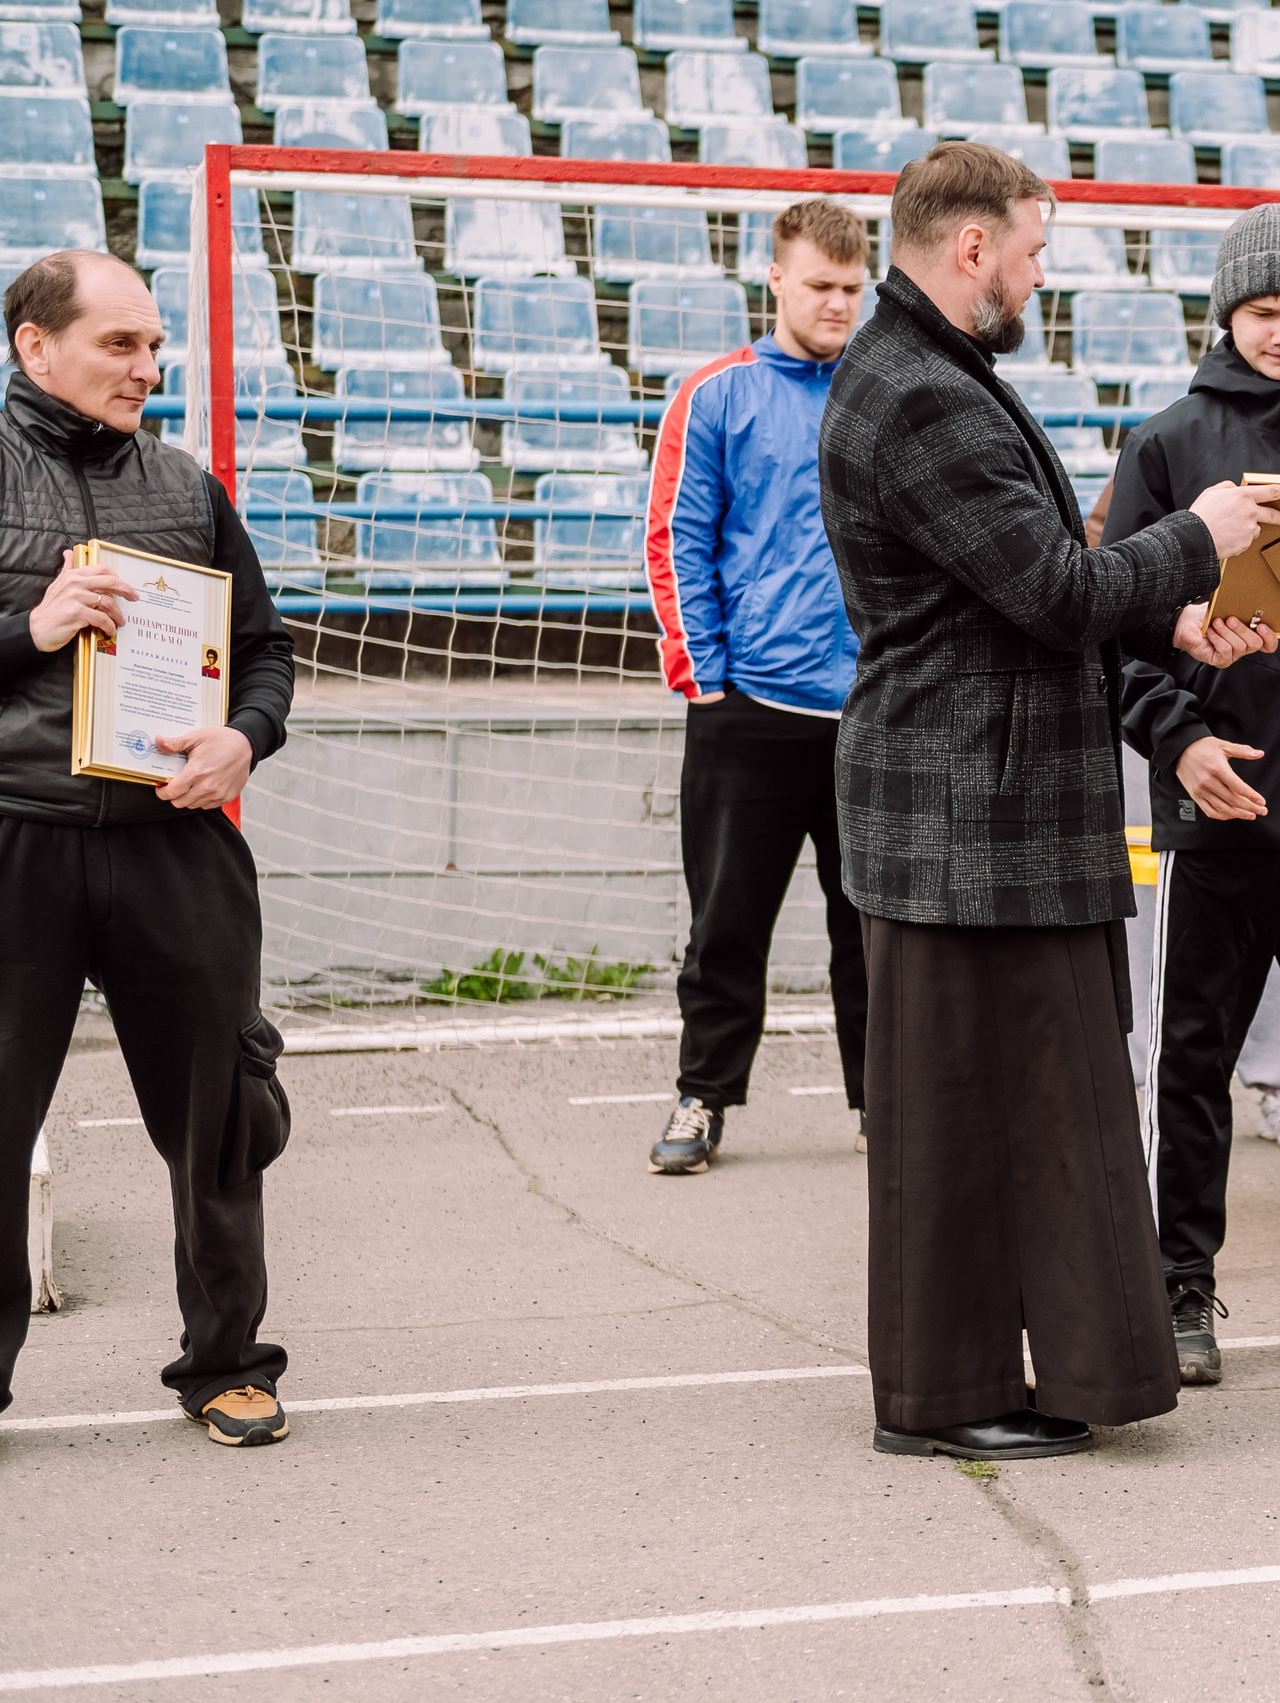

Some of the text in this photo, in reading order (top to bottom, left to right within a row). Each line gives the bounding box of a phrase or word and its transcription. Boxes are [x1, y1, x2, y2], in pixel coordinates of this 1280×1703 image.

[127, 615, 200, 639] ЛАГОДАРСТВЕННОЕ
[137, 629, 183, 646] ПИСЬМО
[130, 649, 188, 666] НАГРАЖДАЕТСЯ
